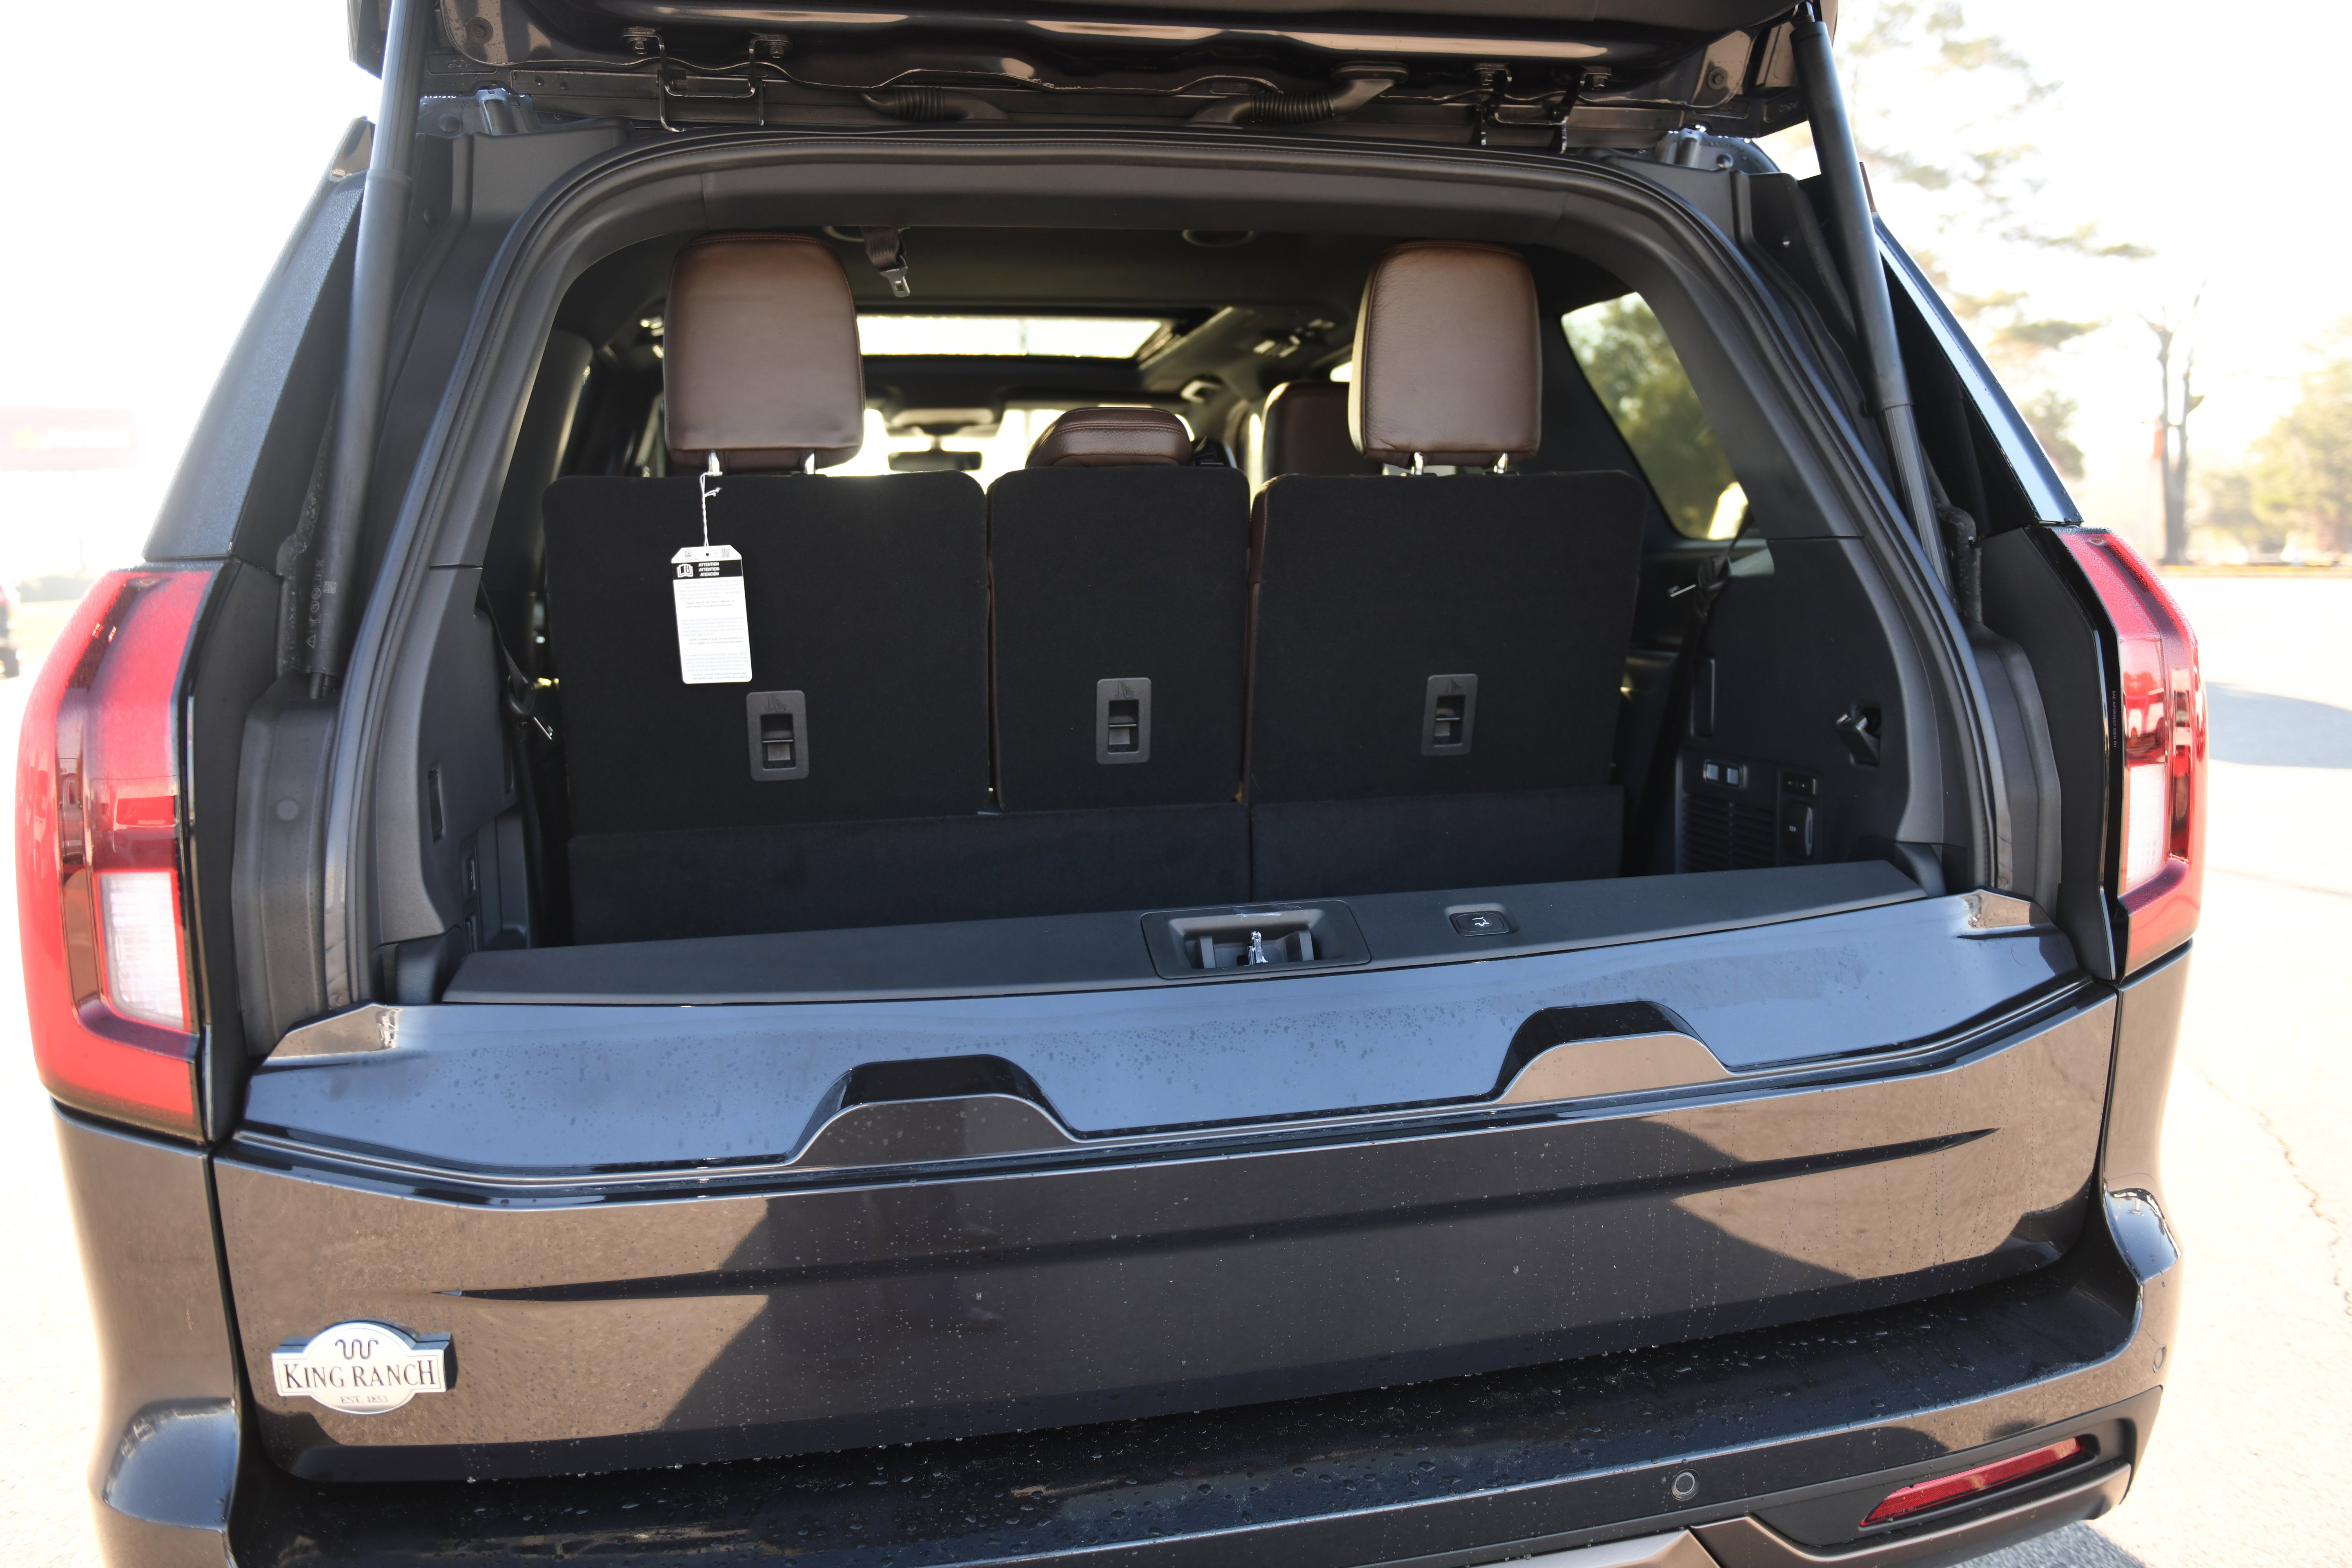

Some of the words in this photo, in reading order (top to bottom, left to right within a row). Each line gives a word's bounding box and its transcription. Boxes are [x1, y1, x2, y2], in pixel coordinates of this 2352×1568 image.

[283, 1364, 345, 1388] KING
[352, 1360, 436, 1387] RANCH
[340, 1396, 363, 1404] EST.
